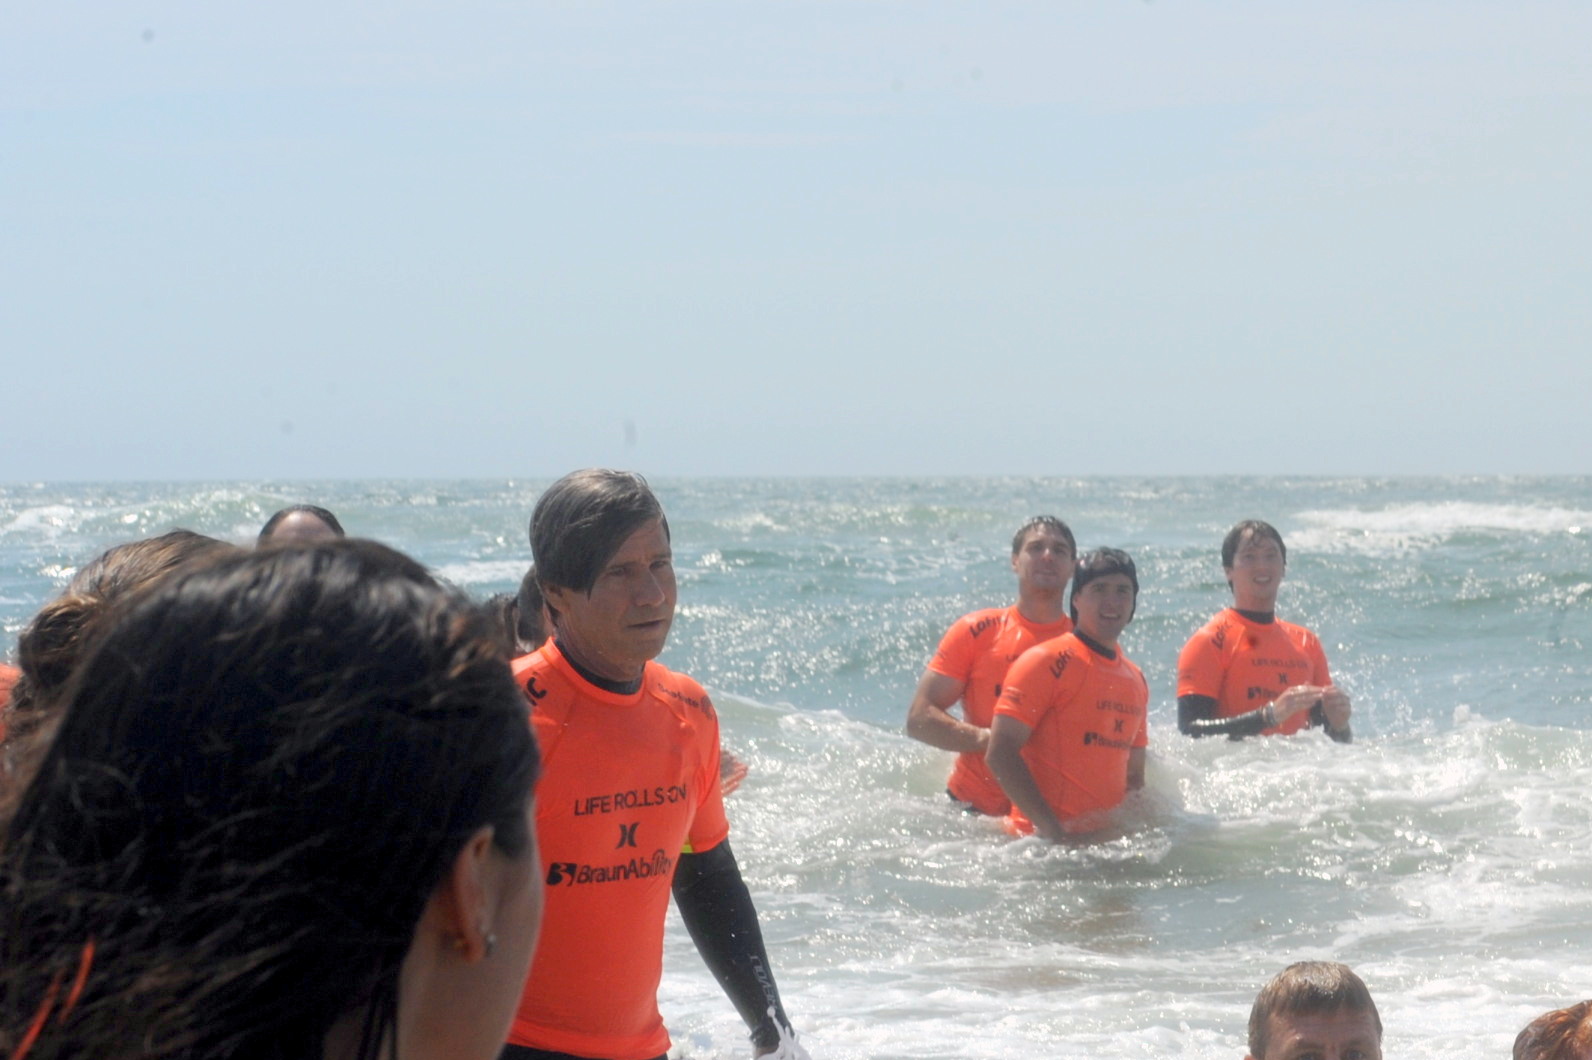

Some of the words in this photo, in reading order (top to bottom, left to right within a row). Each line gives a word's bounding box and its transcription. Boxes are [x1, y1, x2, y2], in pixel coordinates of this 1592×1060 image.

[573, 794, 611, 817] LIFE
[613, 785, 666, 813] ROLLS
[666, 783, 688, 804] ON
